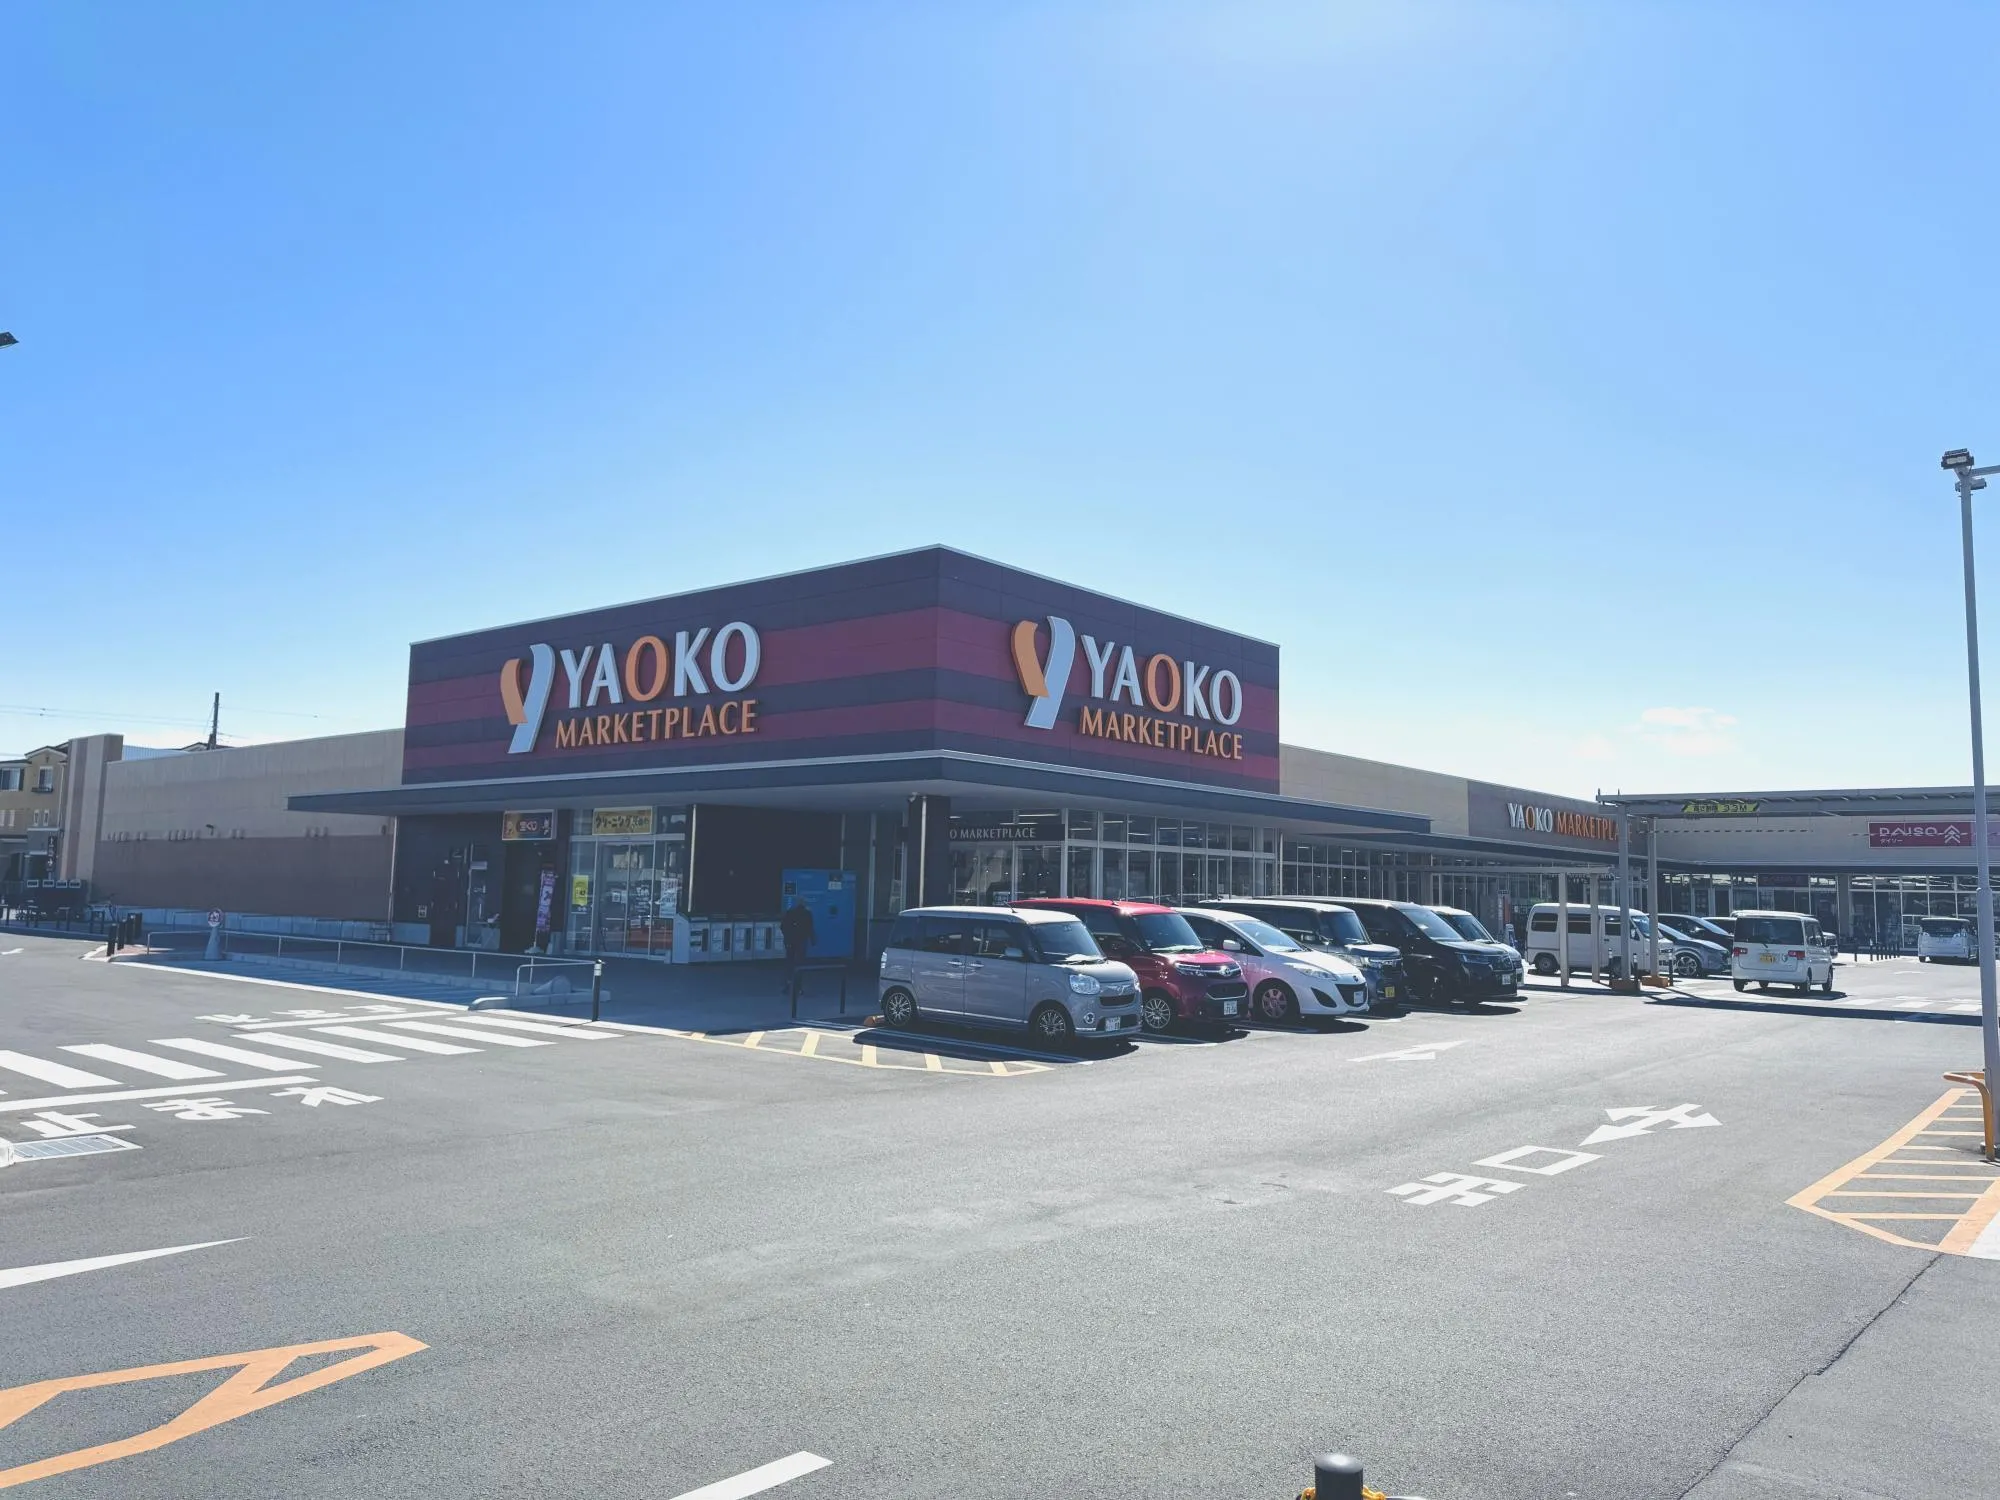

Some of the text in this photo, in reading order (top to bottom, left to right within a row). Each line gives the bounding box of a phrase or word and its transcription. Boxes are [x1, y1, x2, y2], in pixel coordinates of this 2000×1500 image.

[561, 621, 760, 708] YAOKO
[1081, 634, 1242, 725] YAOKO
[555, 699, 758, 749] MARKETPLACE
[1081, 706, 1243, 760] MARKETPLACE
[960, 827, 1036, 839] MARKETPLACE
[1507, 802, 1632, 843] YAOKO MARKETPLAE
[1879, 827, 1938, 836] DAISO
[20, 1086, 384, 1138] 止まれ
[1384, 1145, 1604, 1207] 出口
